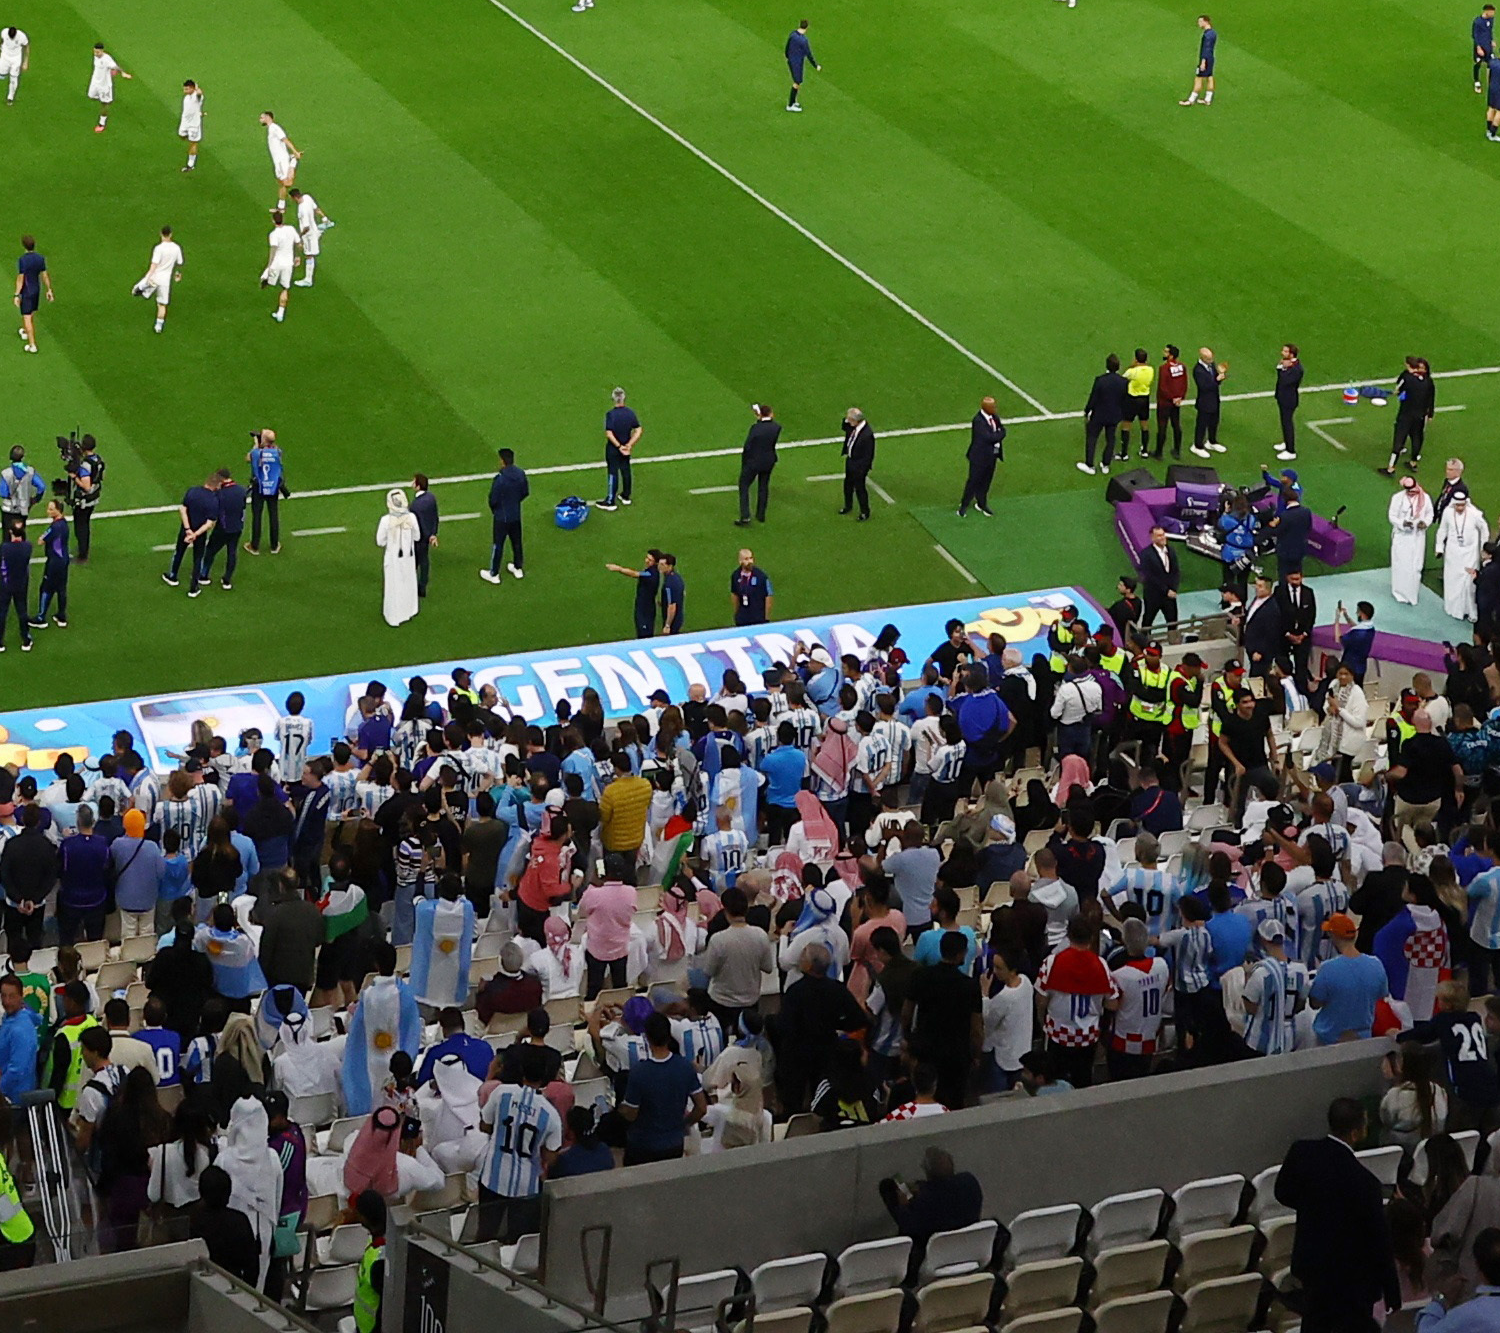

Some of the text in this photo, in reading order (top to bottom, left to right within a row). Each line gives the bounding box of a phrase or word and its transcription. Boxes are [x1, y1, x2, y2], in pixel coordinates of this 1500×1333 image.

[283, 734, 304, 756] 17
[722, 849, 742, 872] 10
[1133, 888, 1164, 916] 10
[1142, 988, 1160, 1018] 10
[1450, 1022, 1488, 1061] 20
[500, 1115, 541, 1158] 10
